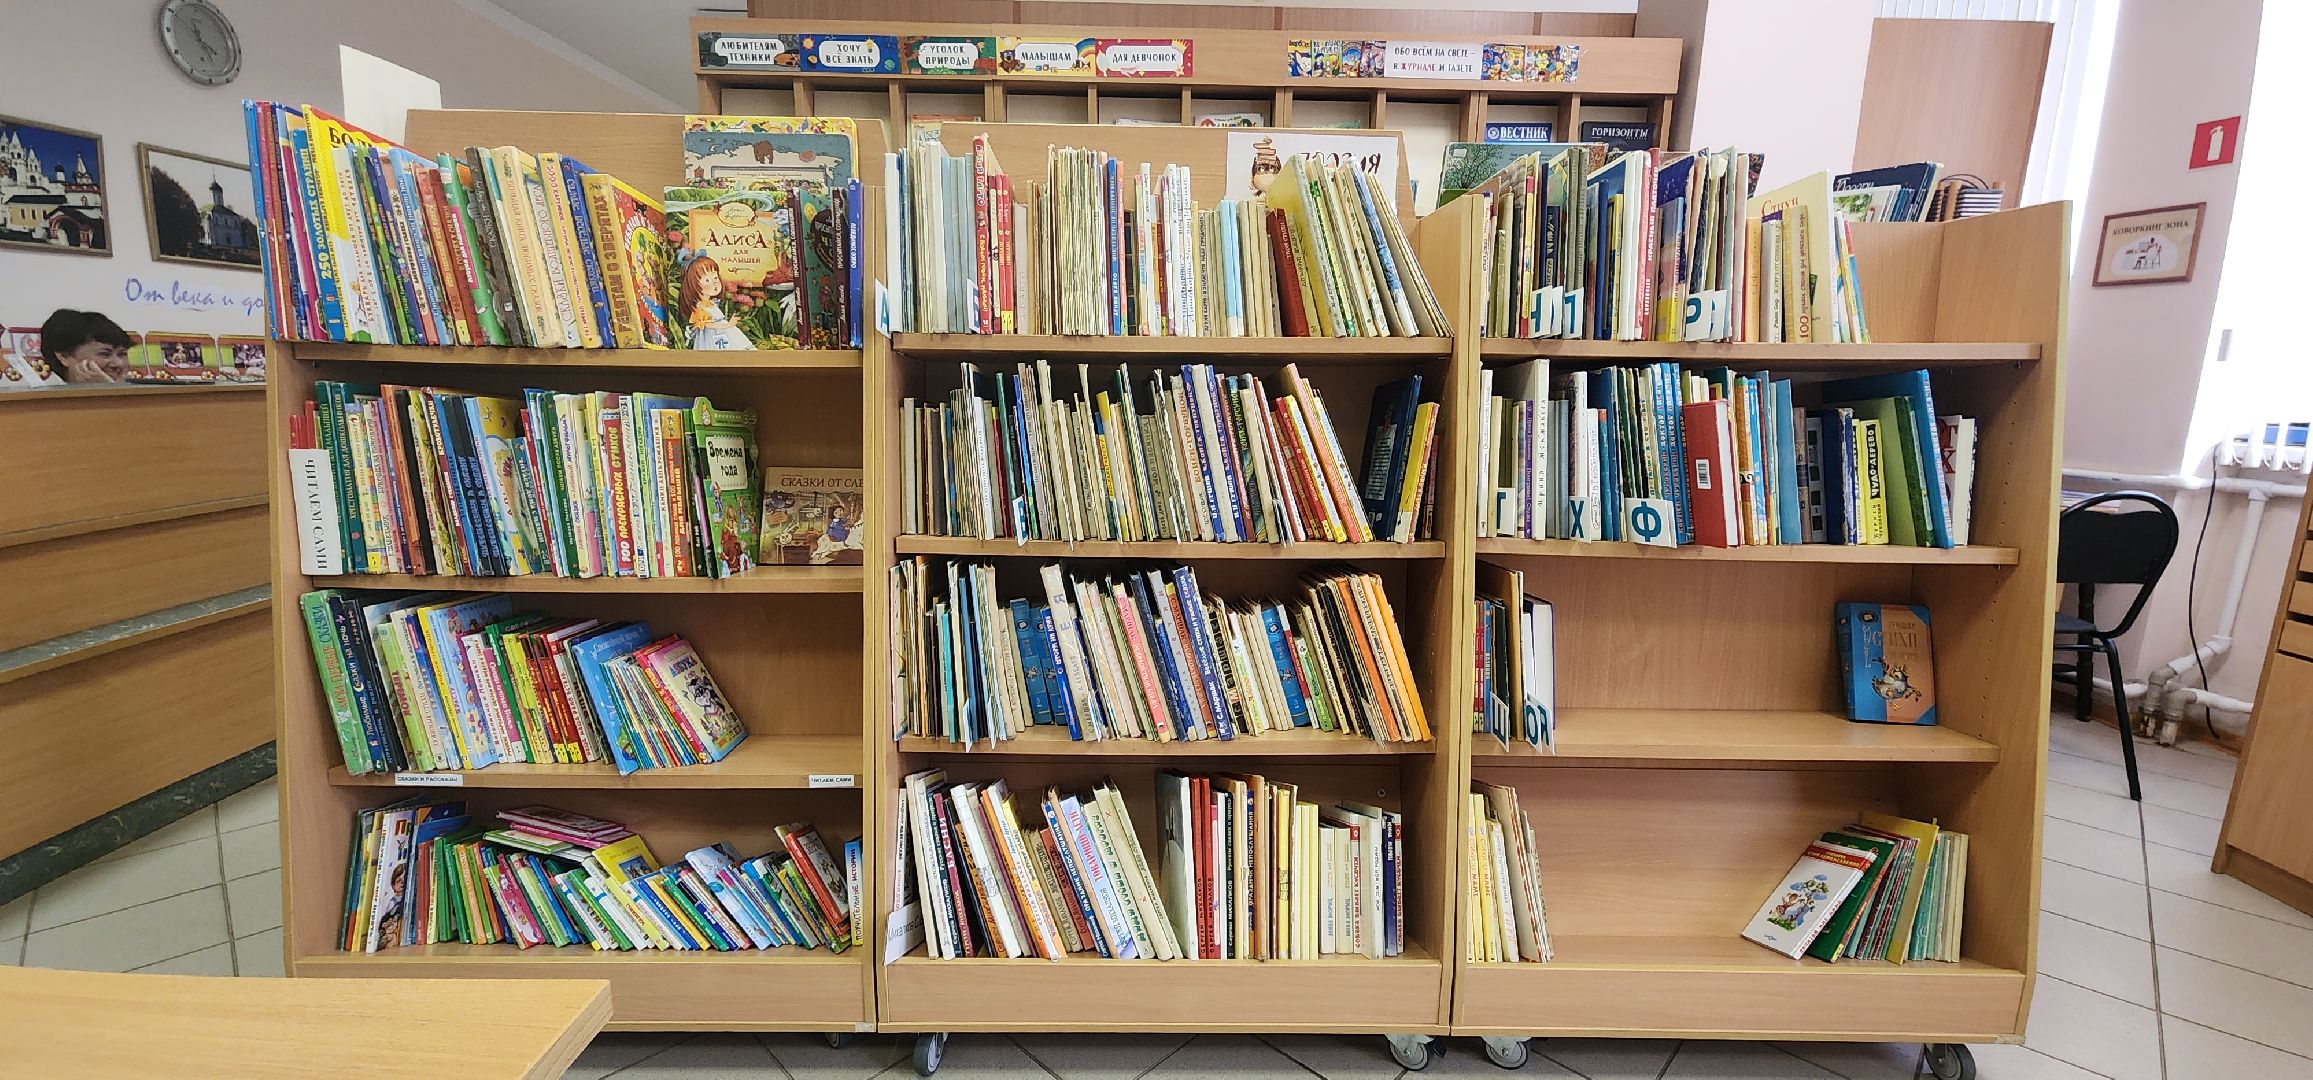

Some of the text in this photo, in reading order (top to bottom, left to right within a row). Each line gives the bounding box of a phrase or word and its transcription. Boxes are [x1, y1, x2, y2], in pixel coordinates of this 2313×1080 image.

[721, 41, 778, 50] ЛЮБИТЕЛЯМ
[729, 52, 770, 62] ТЕХНИКИ
[837, 44, 860, 53] ХОЧУ
[846, 54, 874, 64] ЗНАТЬ
[925, 56, 970, 67] ПРИРОДЫ
[928, 45, 965, 54] УГОЛОК
[1021, 52, 1071, 61] МАЛЫШАМ
[1113, 53, 1176, 63] ДЛЯ ДЕВЧОНОК
[1394, 48, 1468, 58] ОБО НА СВЕТЕ
[1401, 63, 1436, 72] ЖУРНАЛЕ
[1439, 64, 1444, 72] И
[1448, 64, 1472, 72] ГАЗЕТЕ
[1500, 125, 1550, 141] ВЕСТНИК
[1591, 127, 1648, 138] ГОРИЗОНТЫ
[301, 149, 318, 196] СТРАНИЦ
[977, 175, 985, 207] БАРТО
[1650, 166, 1658, 213] ПЛАТОЧЕК
[313, 202, 329, 250] ЗОЛОТЫХ
[599, 195, 619, 256] ЗВЕРЯТАХ
[2113, 221, 2188, 235] КОВОРКИНГ ЗОНА
[321, 252, 332, 279] 250
[610, 261, 619, 273] О
[125, 278, 164, 302] От
[171, 280, 216, 306] века
[558, 277, 574, 322] СКАЗКИ
[1799, 315, 1809, 339] 100
[322, 403, 332, 446] МАЛЫШЕЙ
[334, 394, 349, 453] ДОШКОЛЬНИКОВ
[1657, 414, 1667, 447] ДОКТОР
[1667, 414, 1676, 447] ДОКТОР
[708, 441, 743, 464] Времена
[1867, 429, 1881, 497] ЧУДО-ДЕРЕВО
[721, 464, 738, 476] года
[781, 477, 824, 488] СКАЗКИ
[827, 479, 841, 488] ОТ
[1671, 452, 1680, 498] ЧУКОВСКИЙ
[344, 470, 357, 519] ХРЕСТОМАТИЯ
[607, 426, 633, 563] 100 ПРЕКРАСНЫХ СТИХОВ
[305, 460, 328, 569] ЧИТАЕМ САМИ
[1570, 500, 1584, 538] Х
[1632, 501, 1662, 542] Ф
[312, 604, 332, 645] СКАЗКИ
[336, 624, 348, 643] ночь
[344, 645, 353, 658] на
[390, 671, 412, 717] ТЕРЕМОК
[359, 696, 375, 743] Любимые
[940, 817, 955, 868] БАСНИ
[1053, 823, 1077, 876] НЕПОСЛУШАНИЯ
[943, 878, 954, 918] МИХАЛКОВ
